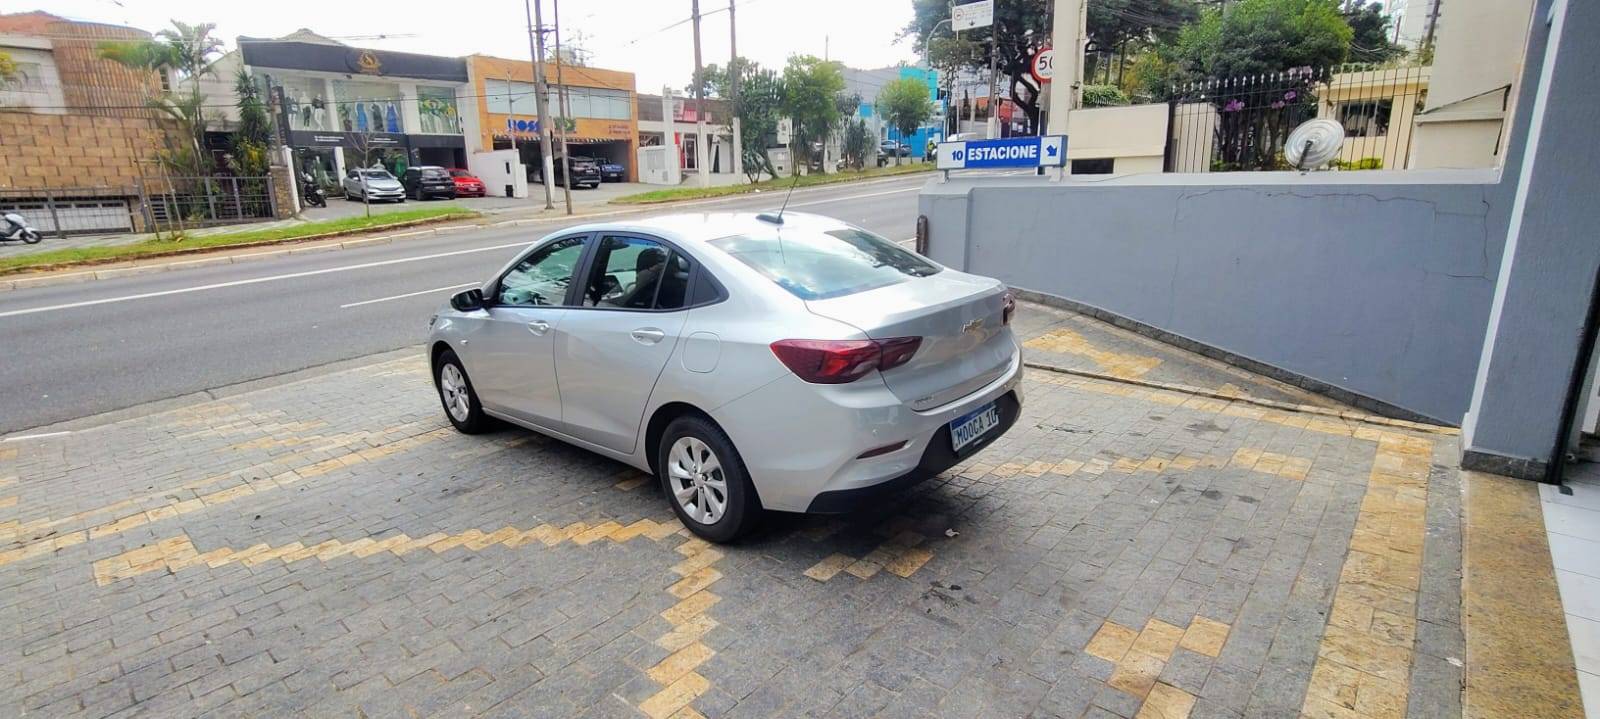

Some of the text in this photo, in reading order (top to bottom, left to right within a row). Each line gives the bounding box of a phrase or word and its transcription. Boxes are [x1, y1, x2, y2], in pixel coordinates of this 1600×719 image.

[951, 144, 1037, 161] 10 ESTACIONE
[956, 408, 998, 445] MOOCA 10
